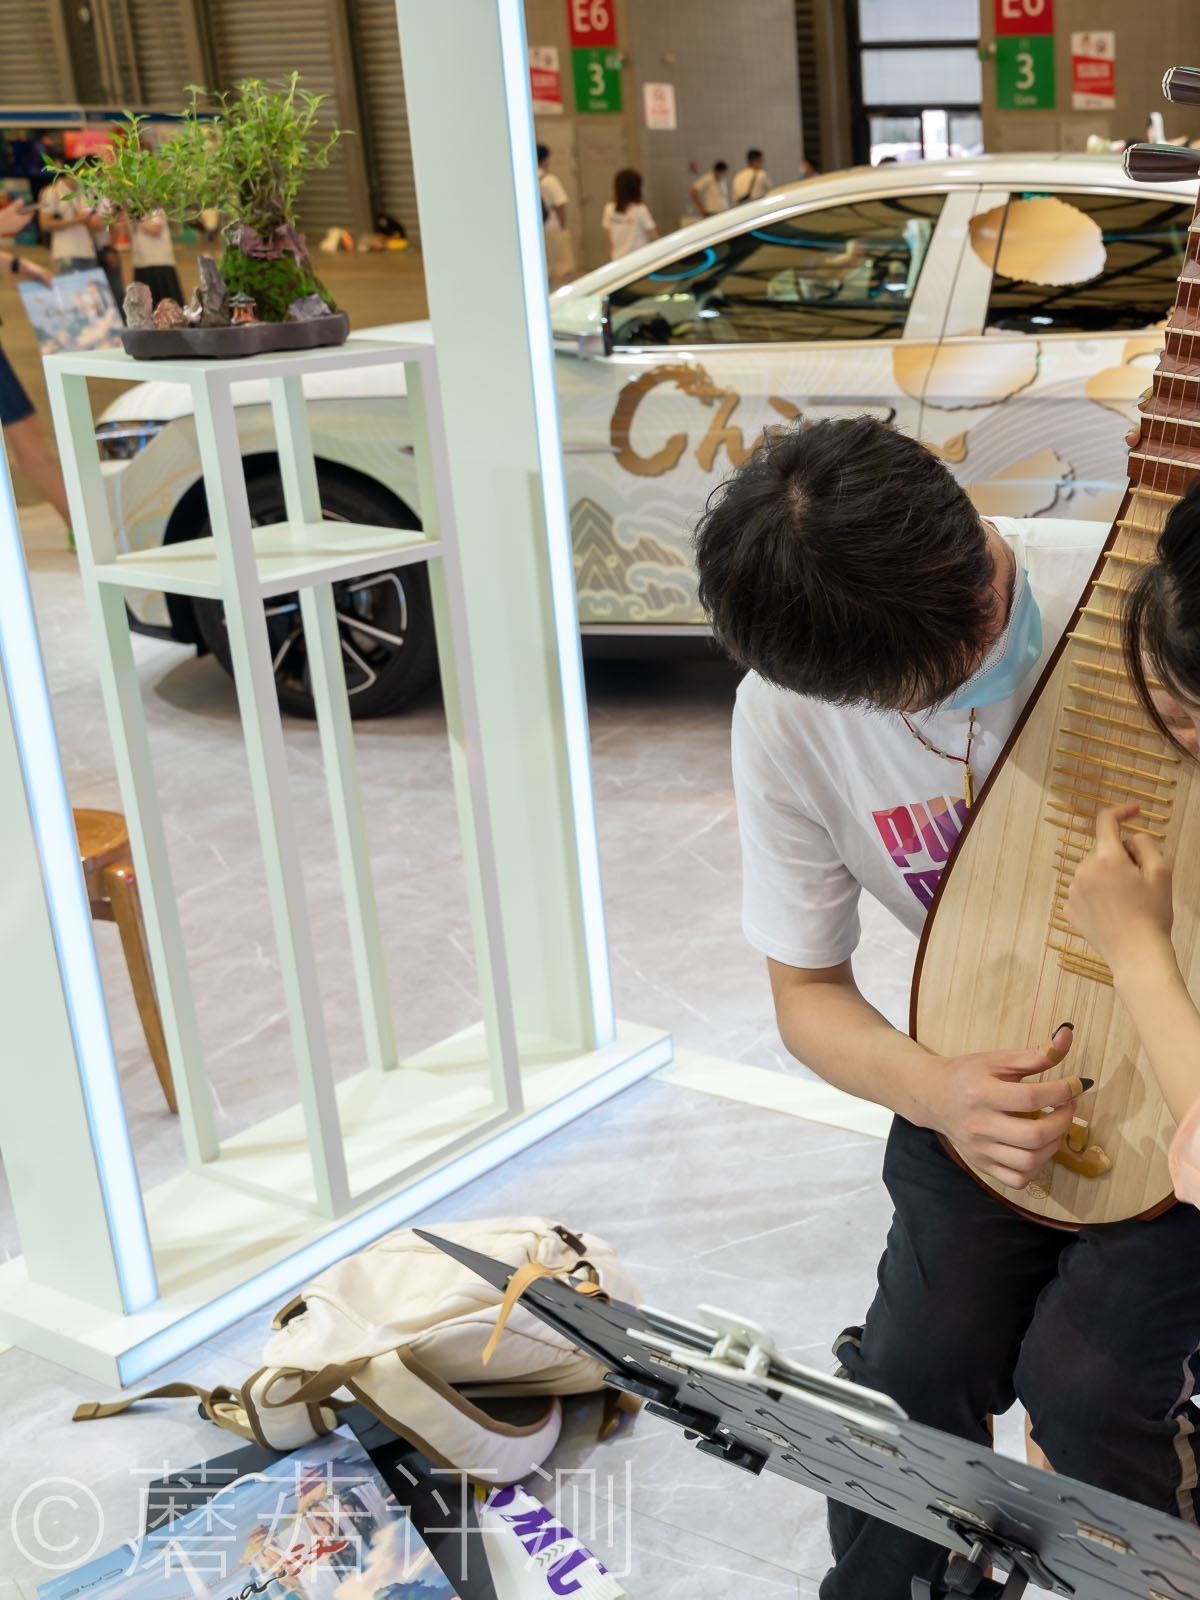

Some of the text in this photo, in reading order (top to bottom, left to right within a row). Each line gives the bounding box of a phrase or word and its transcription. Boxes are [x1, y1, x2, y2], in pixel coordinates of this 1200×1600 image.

[572, 0, 609, 32] E6
[587, 62, 606, 96] 3
[1016, 53, 1035, 90] 3
